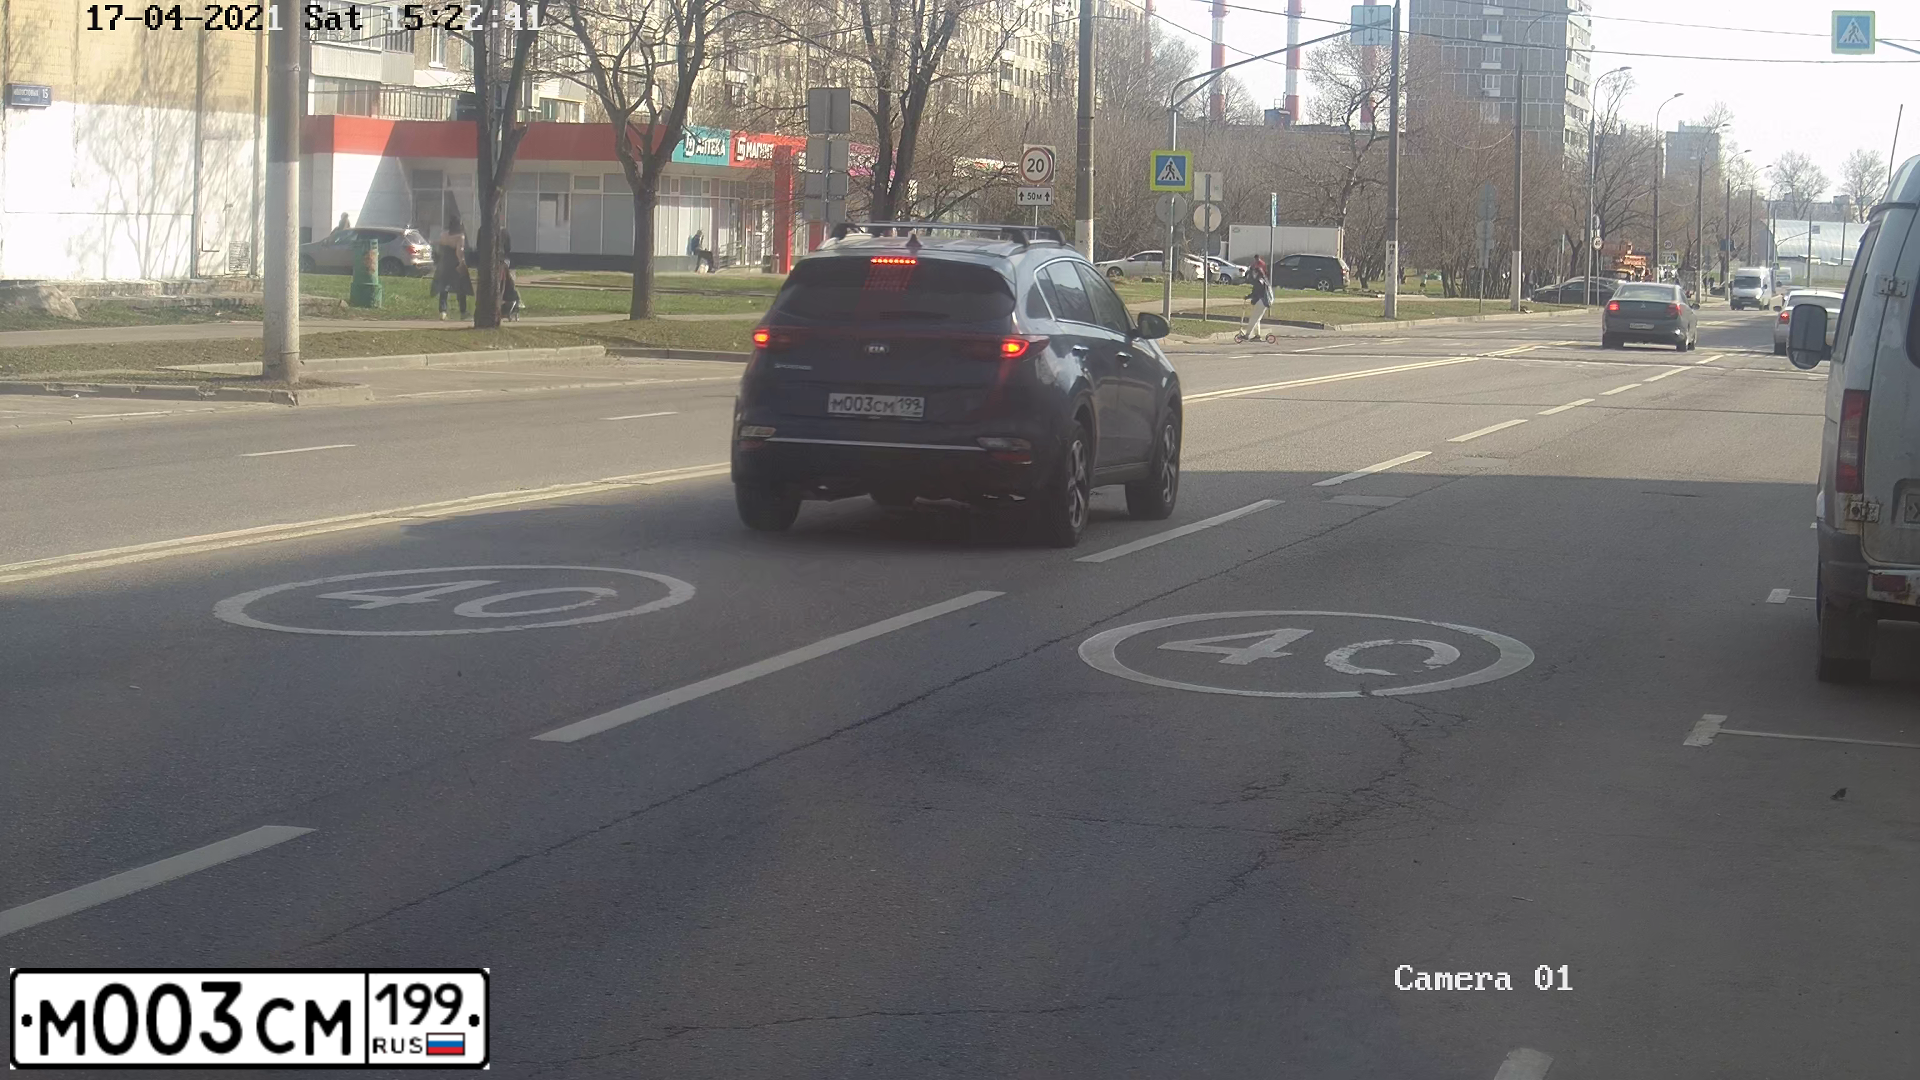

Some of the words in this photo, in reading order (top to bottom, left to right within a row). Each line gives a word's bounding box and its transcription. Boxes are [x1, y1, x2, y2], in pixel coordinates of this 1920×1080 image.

[1026, 158, 1045, 173] 20
[831, 396, 895, 413] М003СМ
[898, 397, 921, 411] 199
[316, 580, 617, 618] 40
